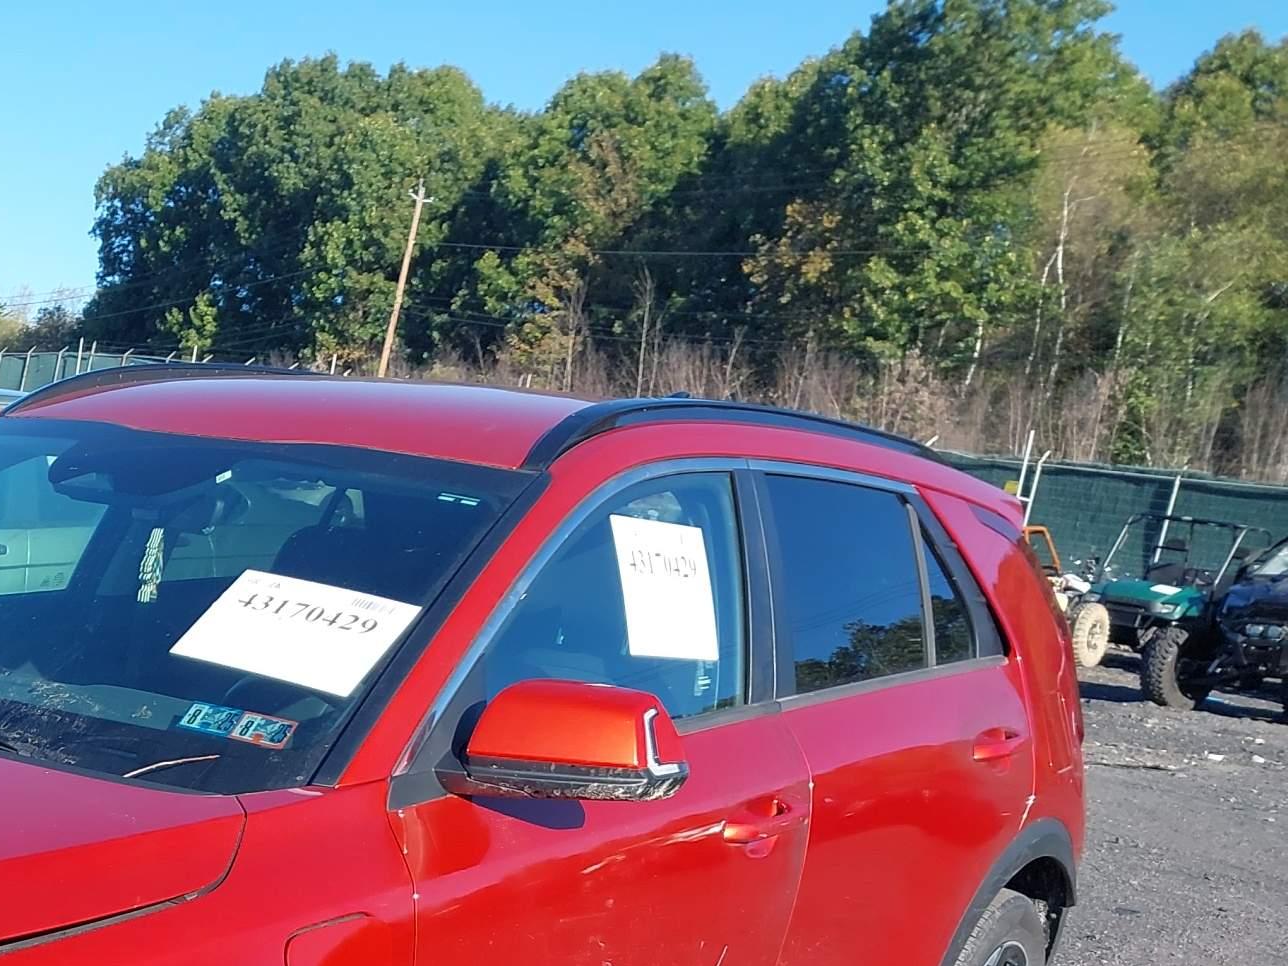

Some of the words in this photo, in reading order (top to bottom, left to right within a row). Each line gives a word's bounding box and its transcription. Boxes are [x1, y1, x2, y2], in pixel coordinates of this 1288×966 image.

[238, 593, 378, 634] 43170429
[188, 709, 202, 725] 8
[240, 720, 254, 737] 8
